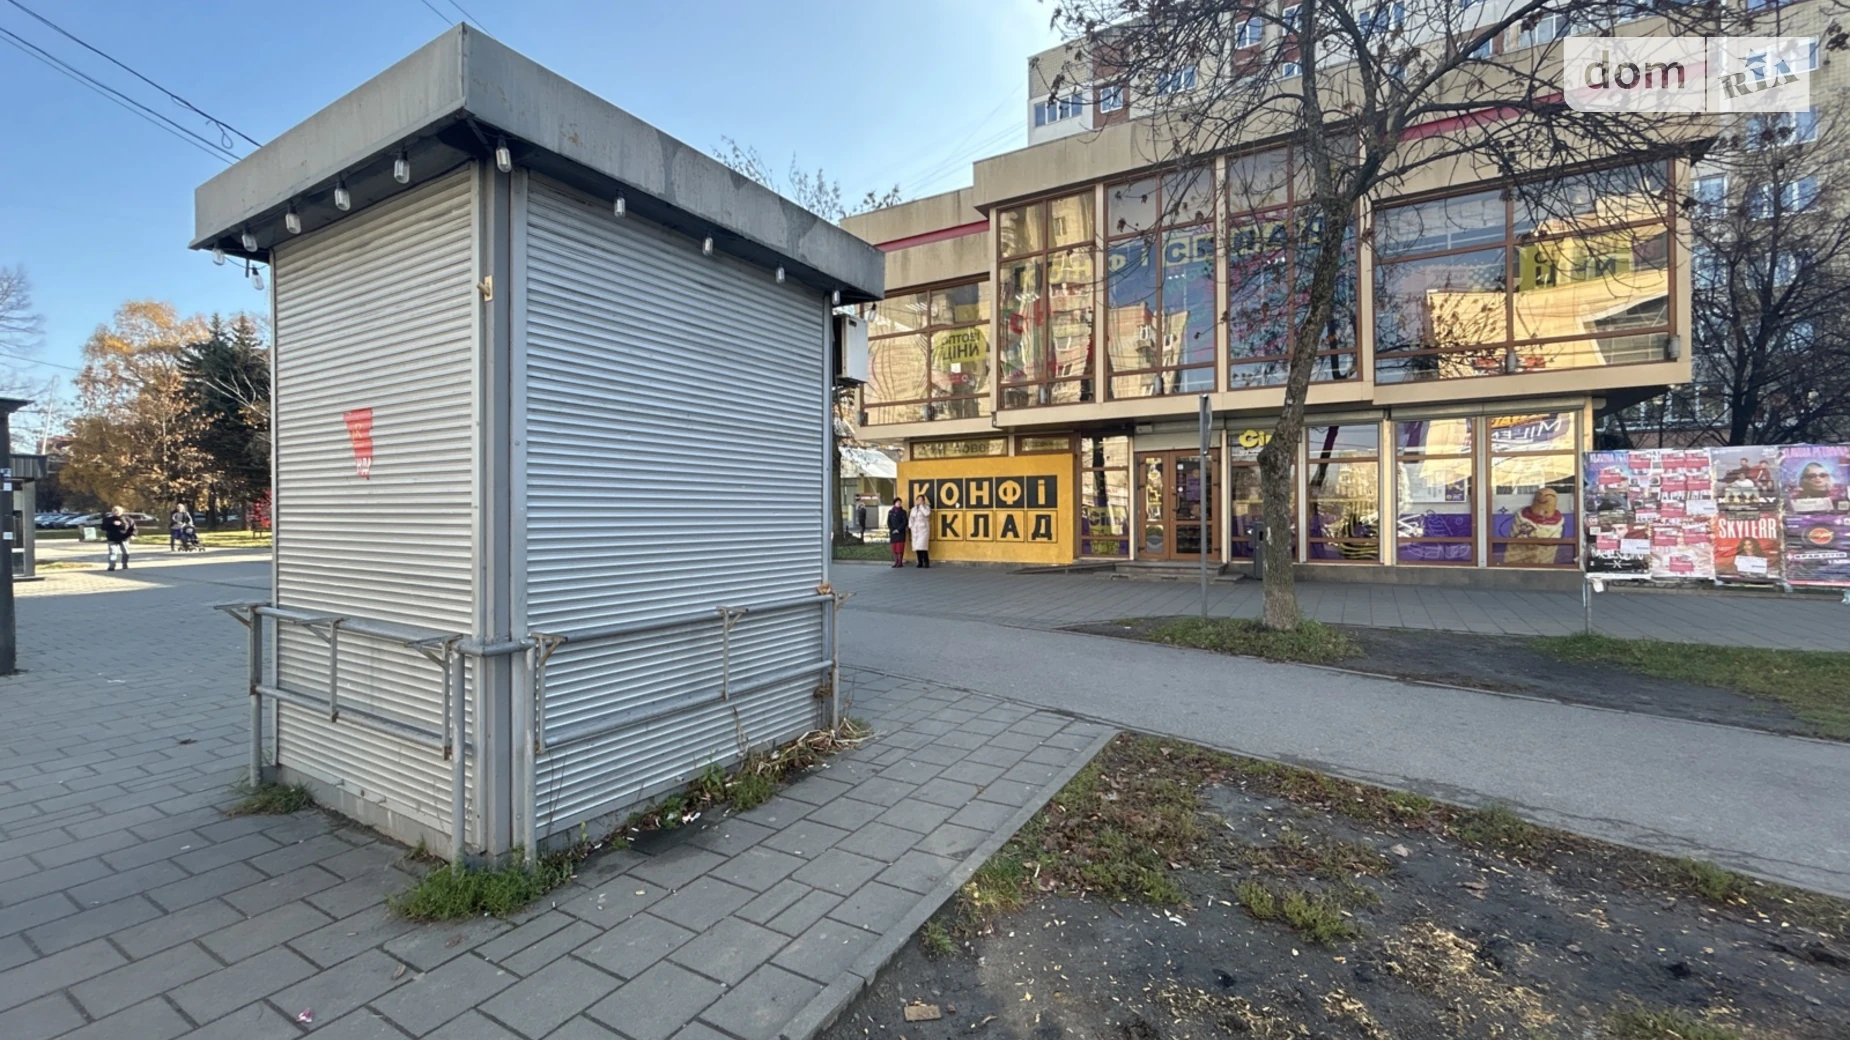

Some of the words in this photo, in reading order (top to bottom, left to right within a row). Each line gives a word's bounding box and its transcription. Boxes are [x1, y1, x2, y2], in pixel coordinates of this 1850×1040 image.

[943, 344, 980, 361] ЦІНИ
[912, 480, 1046, 506] КОНФІ
[940, 513, 1053, 541] КЛАД
